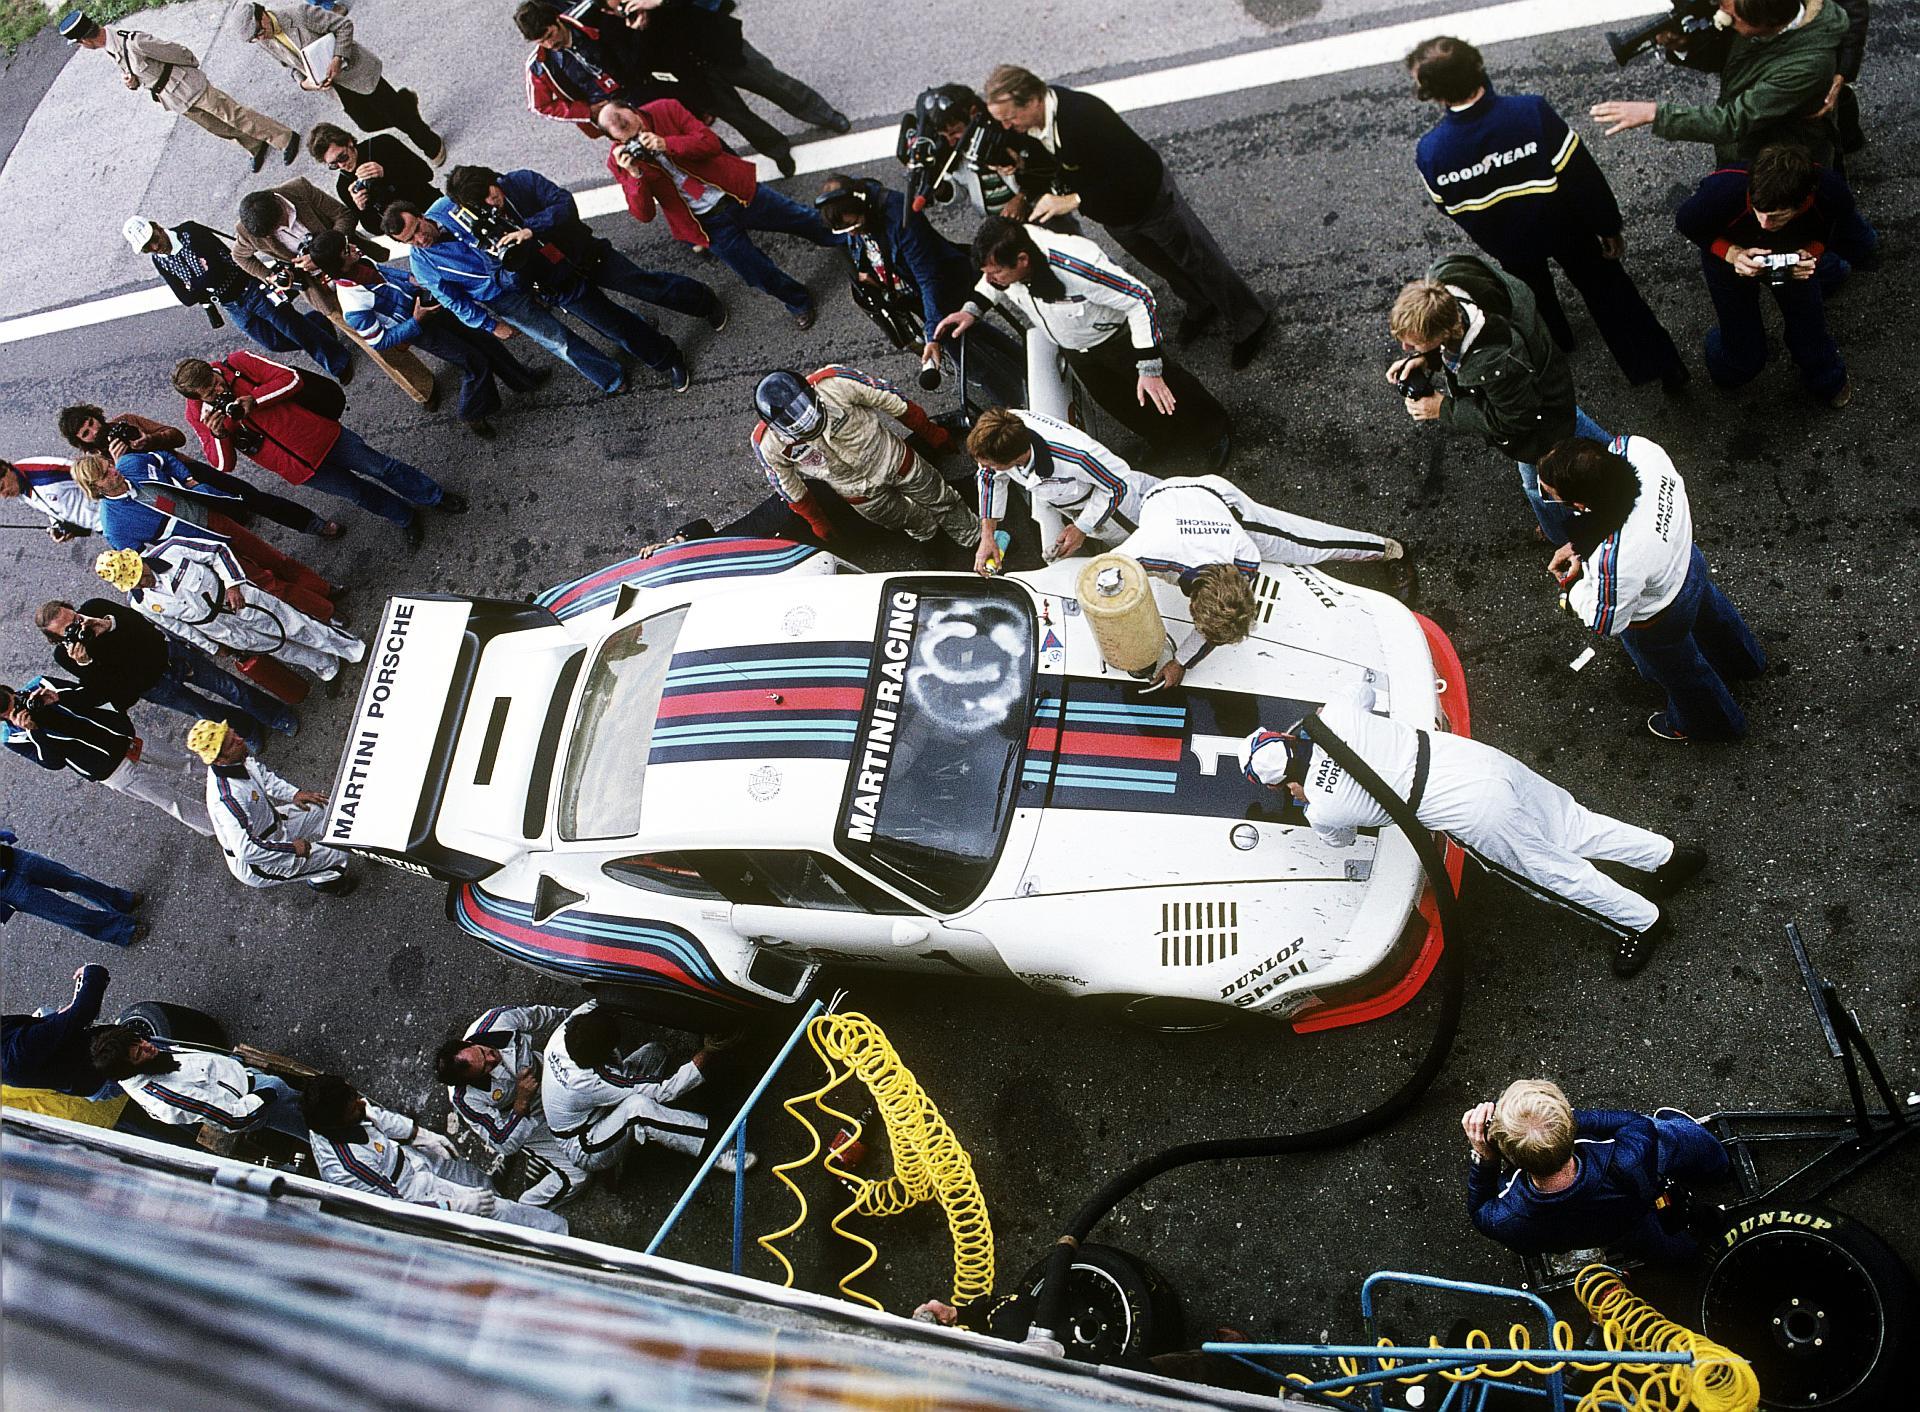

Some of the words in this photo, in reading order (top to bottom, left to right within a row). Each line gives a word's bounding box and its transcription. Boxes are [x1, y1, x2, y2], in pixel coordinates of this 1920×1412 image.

[1437, 141, 1537, 186] GOODYEAR
[1180, 527, 1231, 535] MARTINI
[1656, 475, 1668, 534] MARTINI
[1662, 477, 1676, 543] PORSCHE
[332, 731, 379, 839] MARTINI
[367, 604, 414, 718] PORSCHE
[848, 708, 898, 843] MARTINI
[876, 591, 918, 704] RACING
[1221, 936, 1304, 999] DUNLOP
[1234, 959, 1309, 1006] Shell
[1724, 1210, 1832, 1247] DUNLOP
